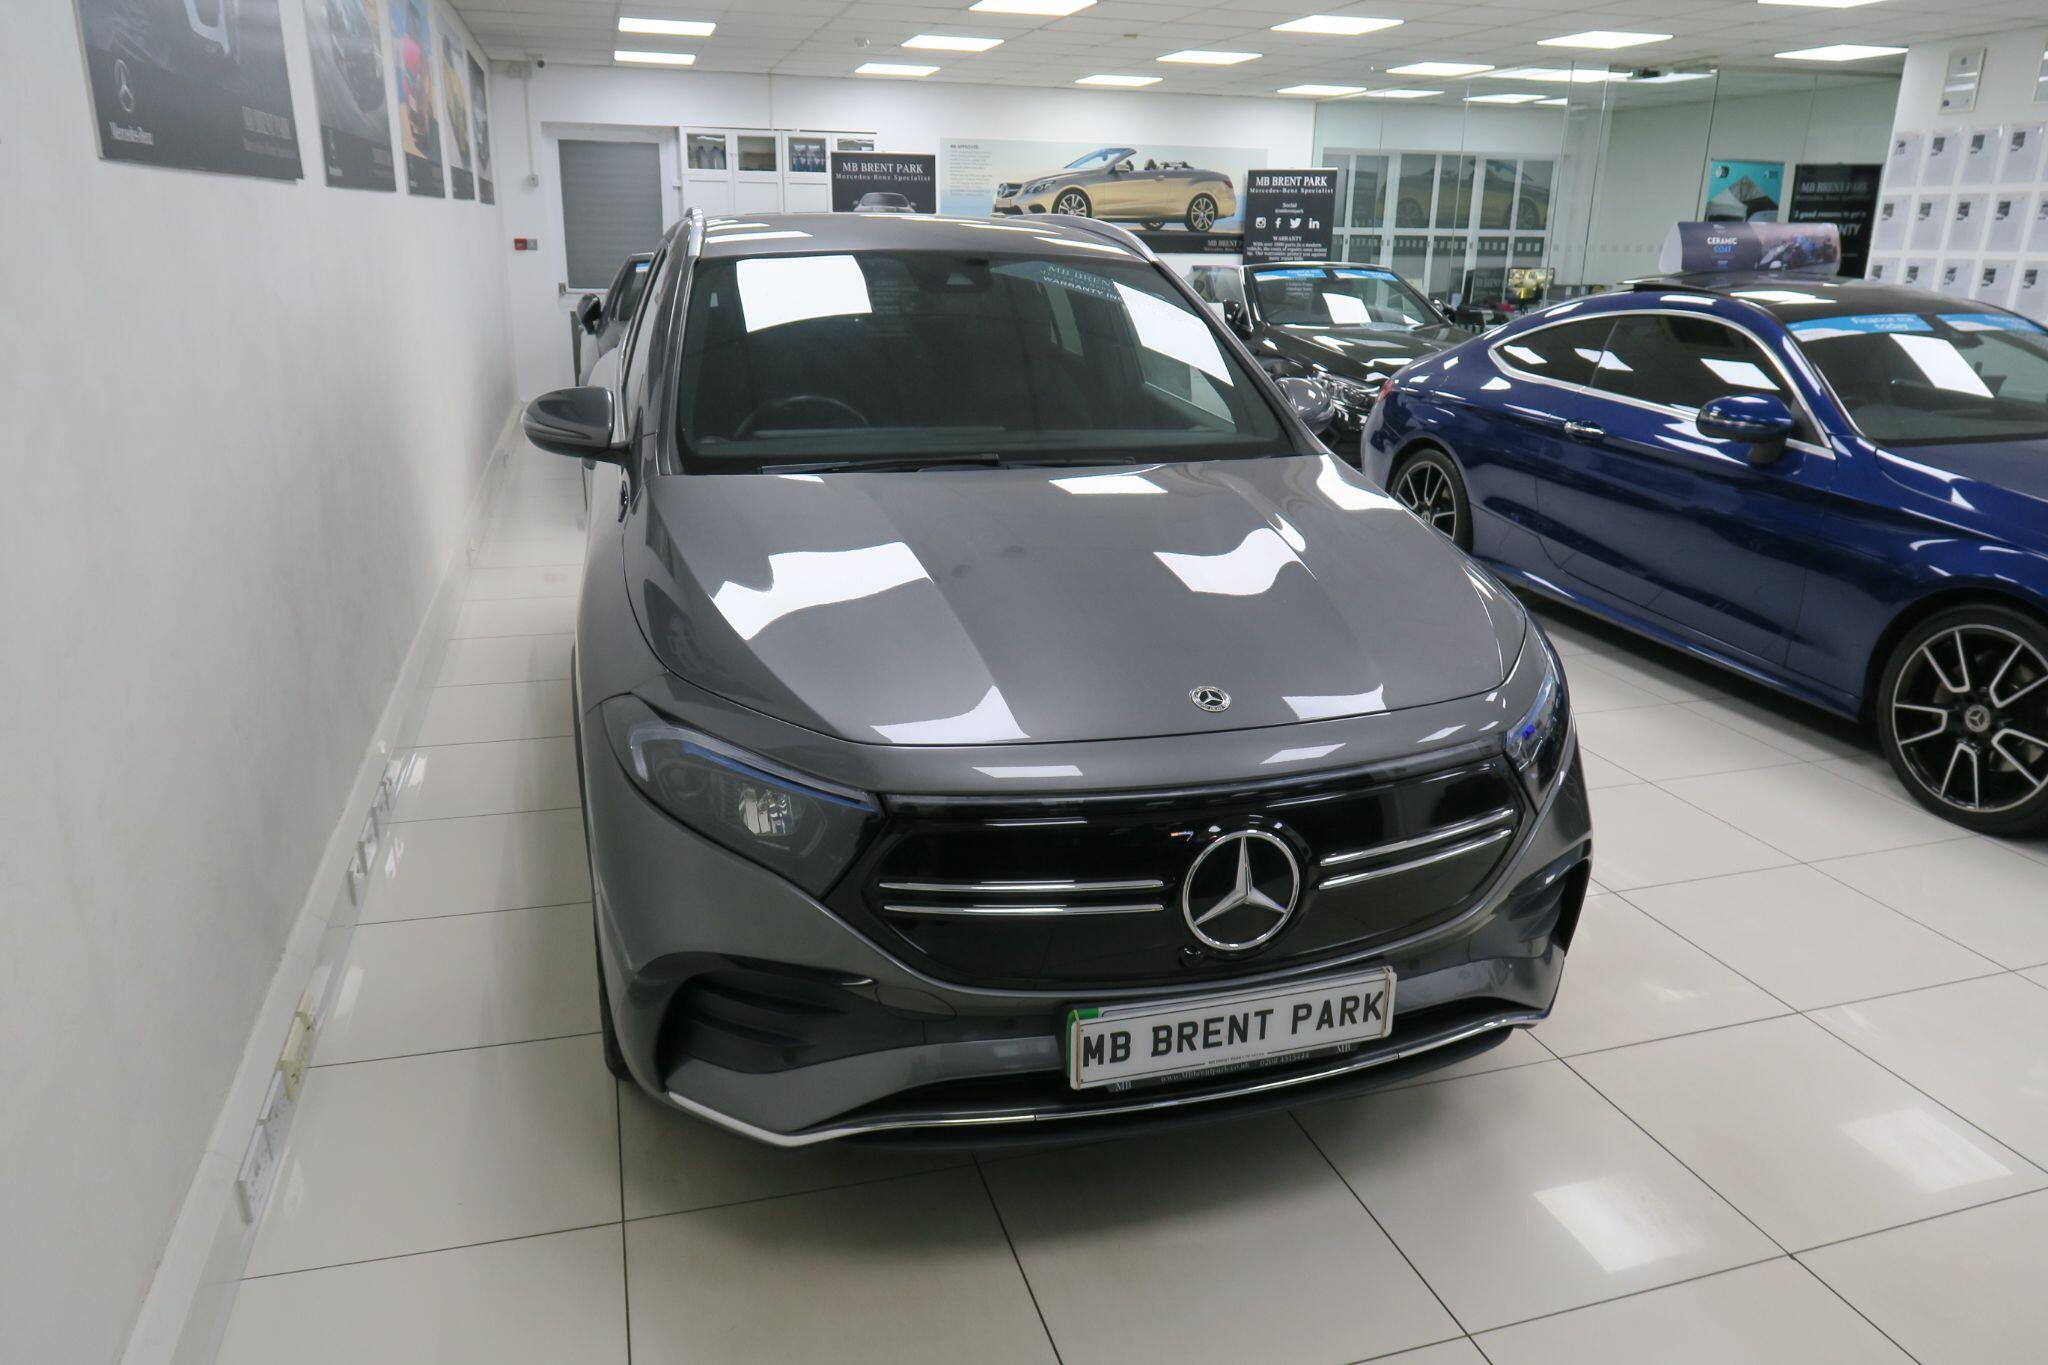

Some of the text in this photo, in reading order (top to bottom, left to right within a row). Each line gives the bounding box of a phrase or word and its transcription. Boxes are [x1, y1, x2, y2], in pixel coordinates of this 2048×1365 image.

[842, 162, 923, 174] MB BRENT PARK
[1256, 176, 1328, 186] MB BRENT PARK
[1707, 237, 1738, 245] CERAMIC
[1043, 276, 1103, 295] WARRANTY
[1083, 991, 1384, 1067] MB BRENT PARK
[1115, 1080, 1132, 1092] MB
